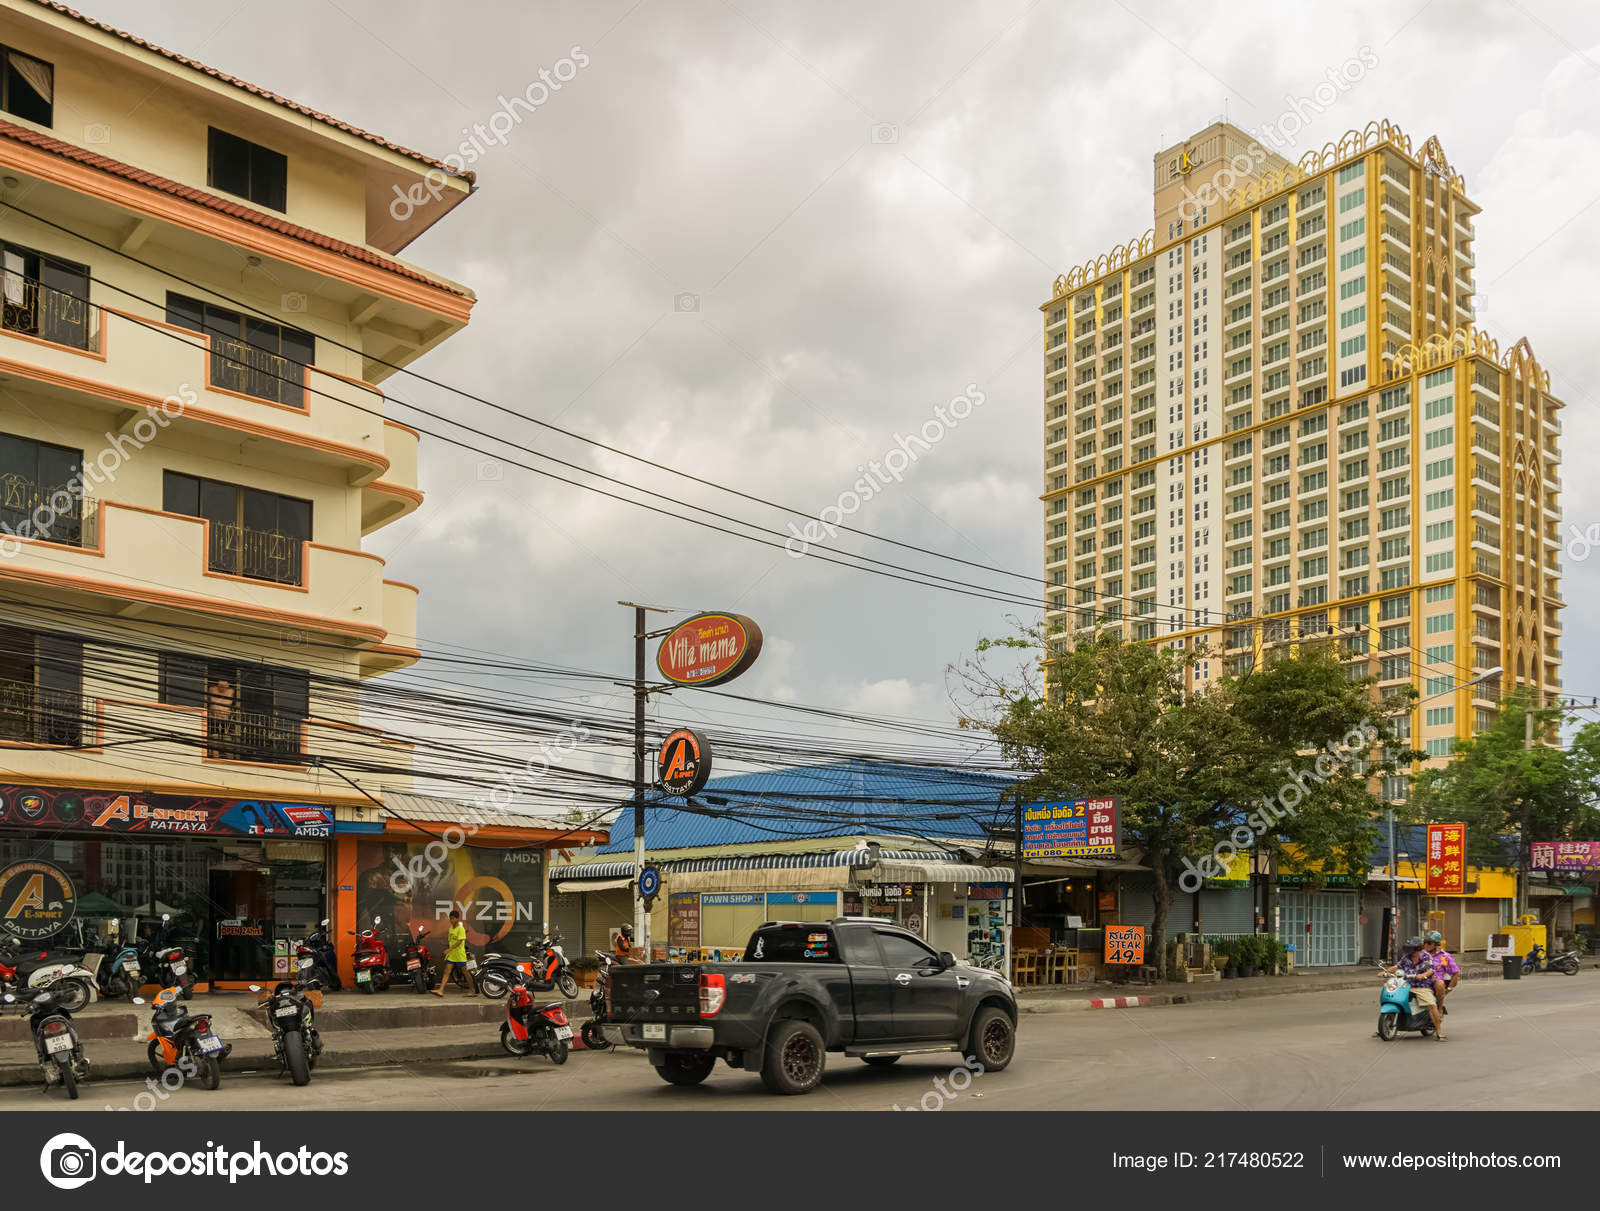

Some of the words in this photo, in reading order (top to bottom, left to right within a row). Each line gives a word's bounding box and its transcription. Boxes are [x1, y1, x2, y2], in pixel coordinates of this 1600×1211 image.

[668, 636, 697, 669] Villa
[699, 635, 738, 664] mama
[664, 778, 693, 793] PATTAYA
[1075, 806, 1086, 817] 2
[150, 820, 208, 831] PATTAYA
[295, 827, 321, 837] AMD
[504, 853, 531, 863] AMD
[1557, 855, 1592, 865] KTV
[703, 895, 729, 904] PAWN
[729, 895, 753, 903] SHOP
[435, 900, 533, 921] RYZEN
[5, 920, 62, 937] PATTAYA
[1108, 941, 1142, 949] STEAK
[614, 1006, 696, 1014] RANGER
